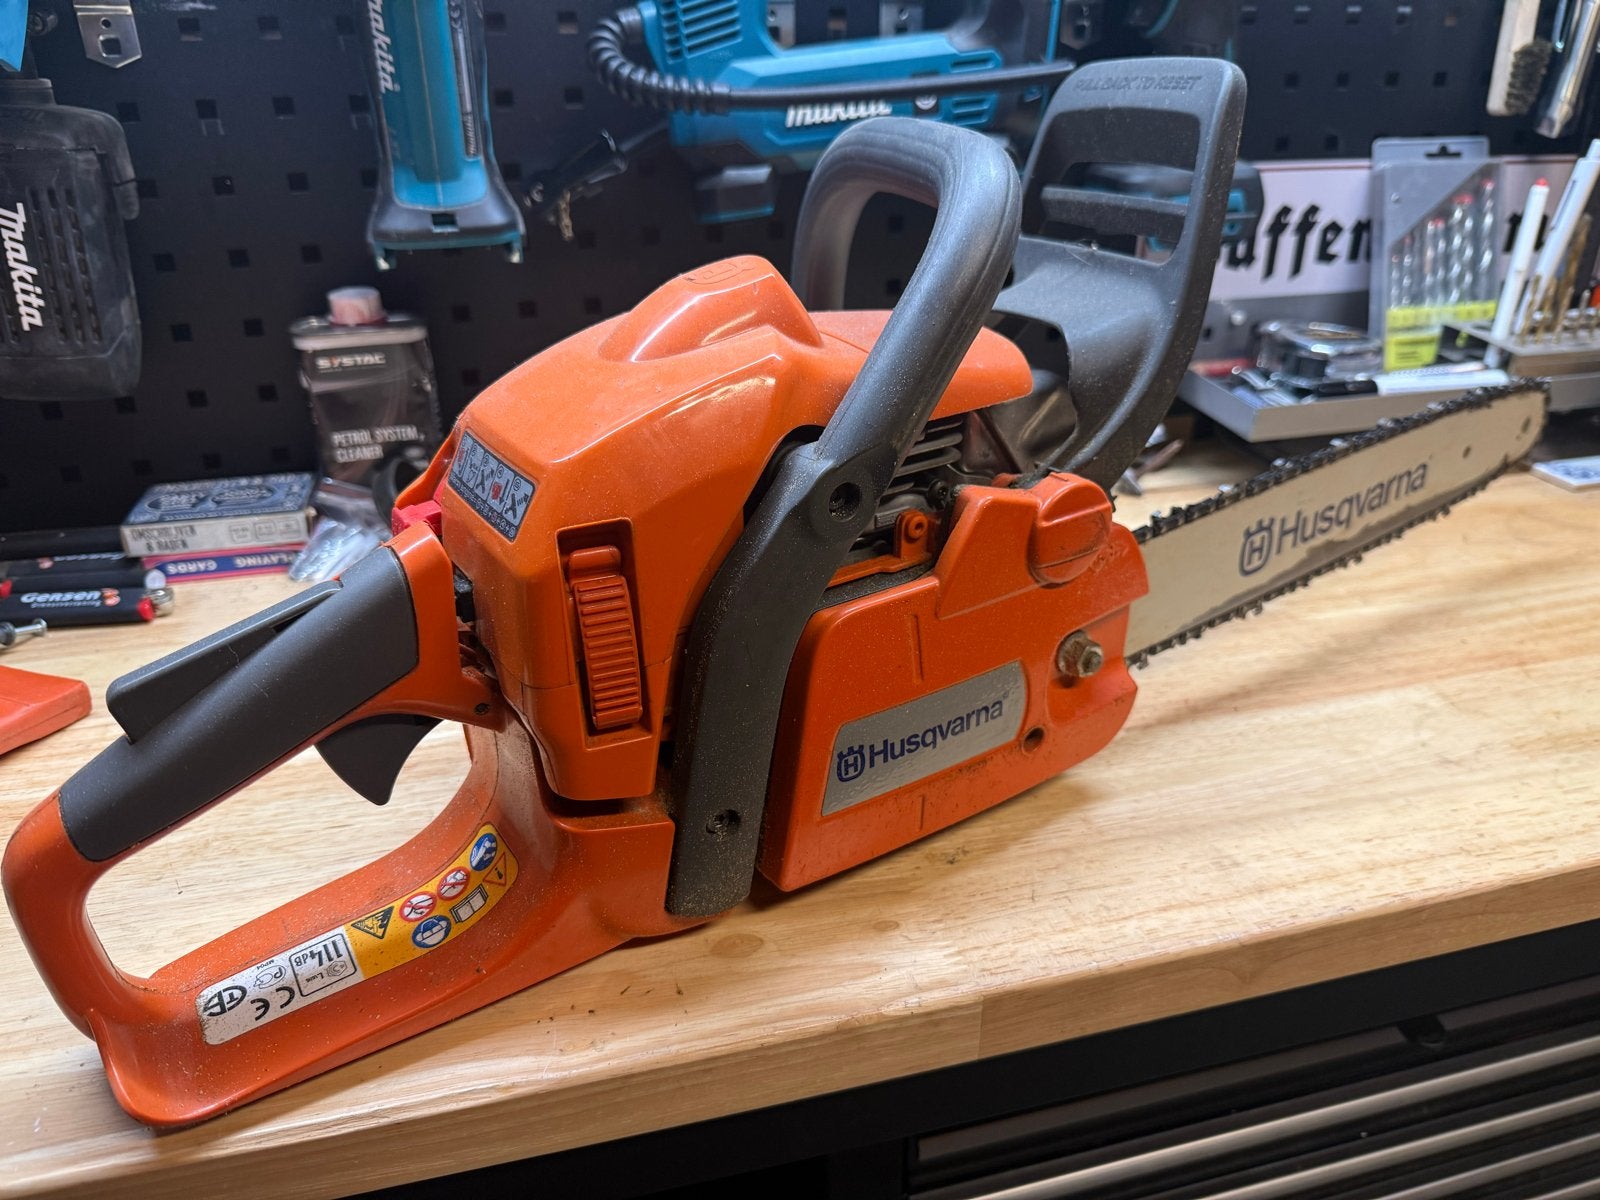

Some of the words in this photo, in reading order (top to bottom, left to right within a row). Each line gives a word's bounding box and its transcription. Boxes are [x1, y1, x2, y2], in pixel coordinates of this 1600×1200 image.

[1155, 76, 1202, 90] RESET
[1216, 203, 1371, 281] affen
[316, 352, 386, 369] SYSTAC
[331, 428, 373, 447] PETROL
[374, 424, 419, 443] SYSTEM
[335, 444, 385, 463] CLEANER
[1276, 462, 1429, 554] Husqvarna
[167, 559, 218, 575] CARDS
[868, 699, 1004, 769] Husqvarna
